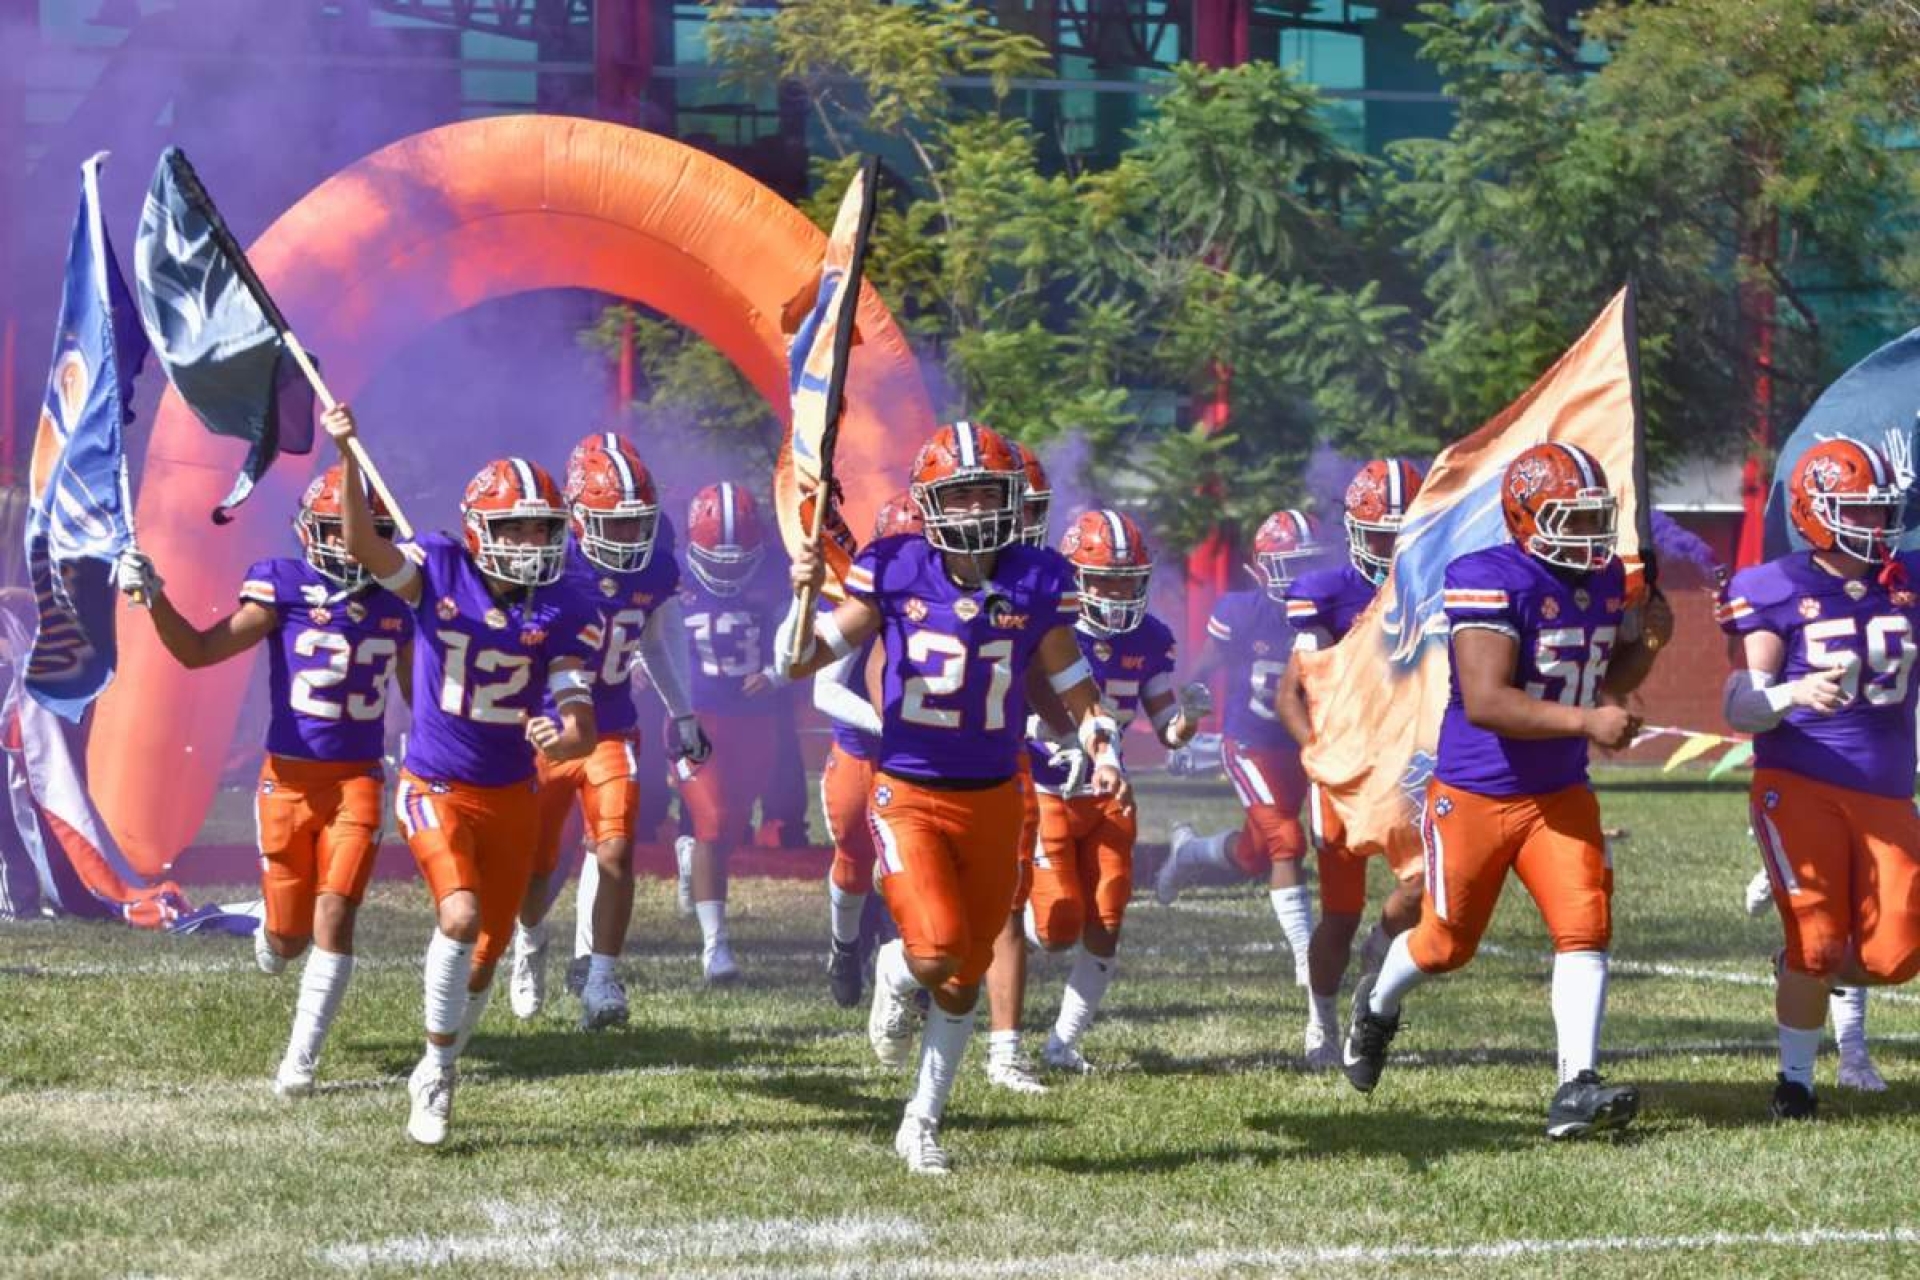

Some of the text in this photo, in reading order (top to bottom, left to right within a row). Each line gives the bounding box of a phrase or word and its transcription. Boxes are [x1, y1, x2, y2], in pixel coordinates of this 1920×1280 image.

[290, 629, 398, 721] 23
[436, 630, 532, 724] 12
[685, 612, 761, 676] 13
[901, 630, 1014, 731] 21
[1804, 615, 1918, 705] 59
